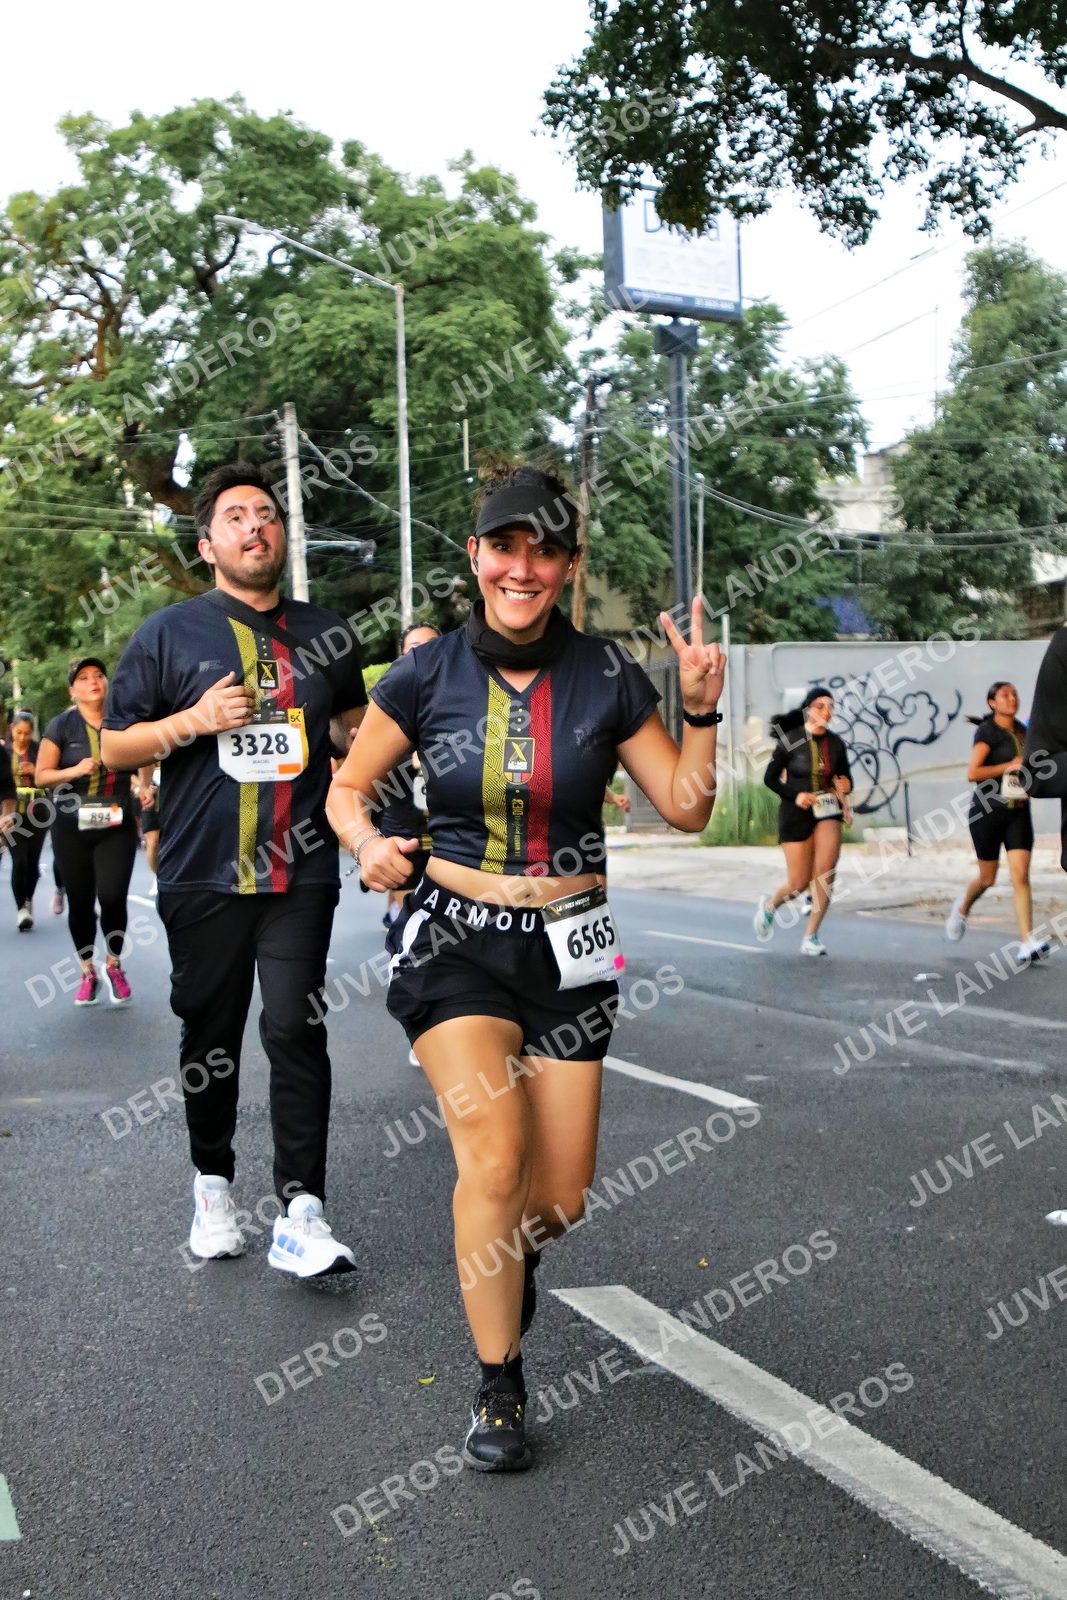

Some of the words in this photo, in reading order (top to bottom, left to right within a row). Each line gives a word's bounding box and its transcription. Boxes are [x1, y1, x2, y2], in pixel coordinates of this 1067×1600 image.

[230, 732, 289, 757] 3328
[423, 888, 547, 933] ARMOU
[567, 915, 615, 960] 6565
